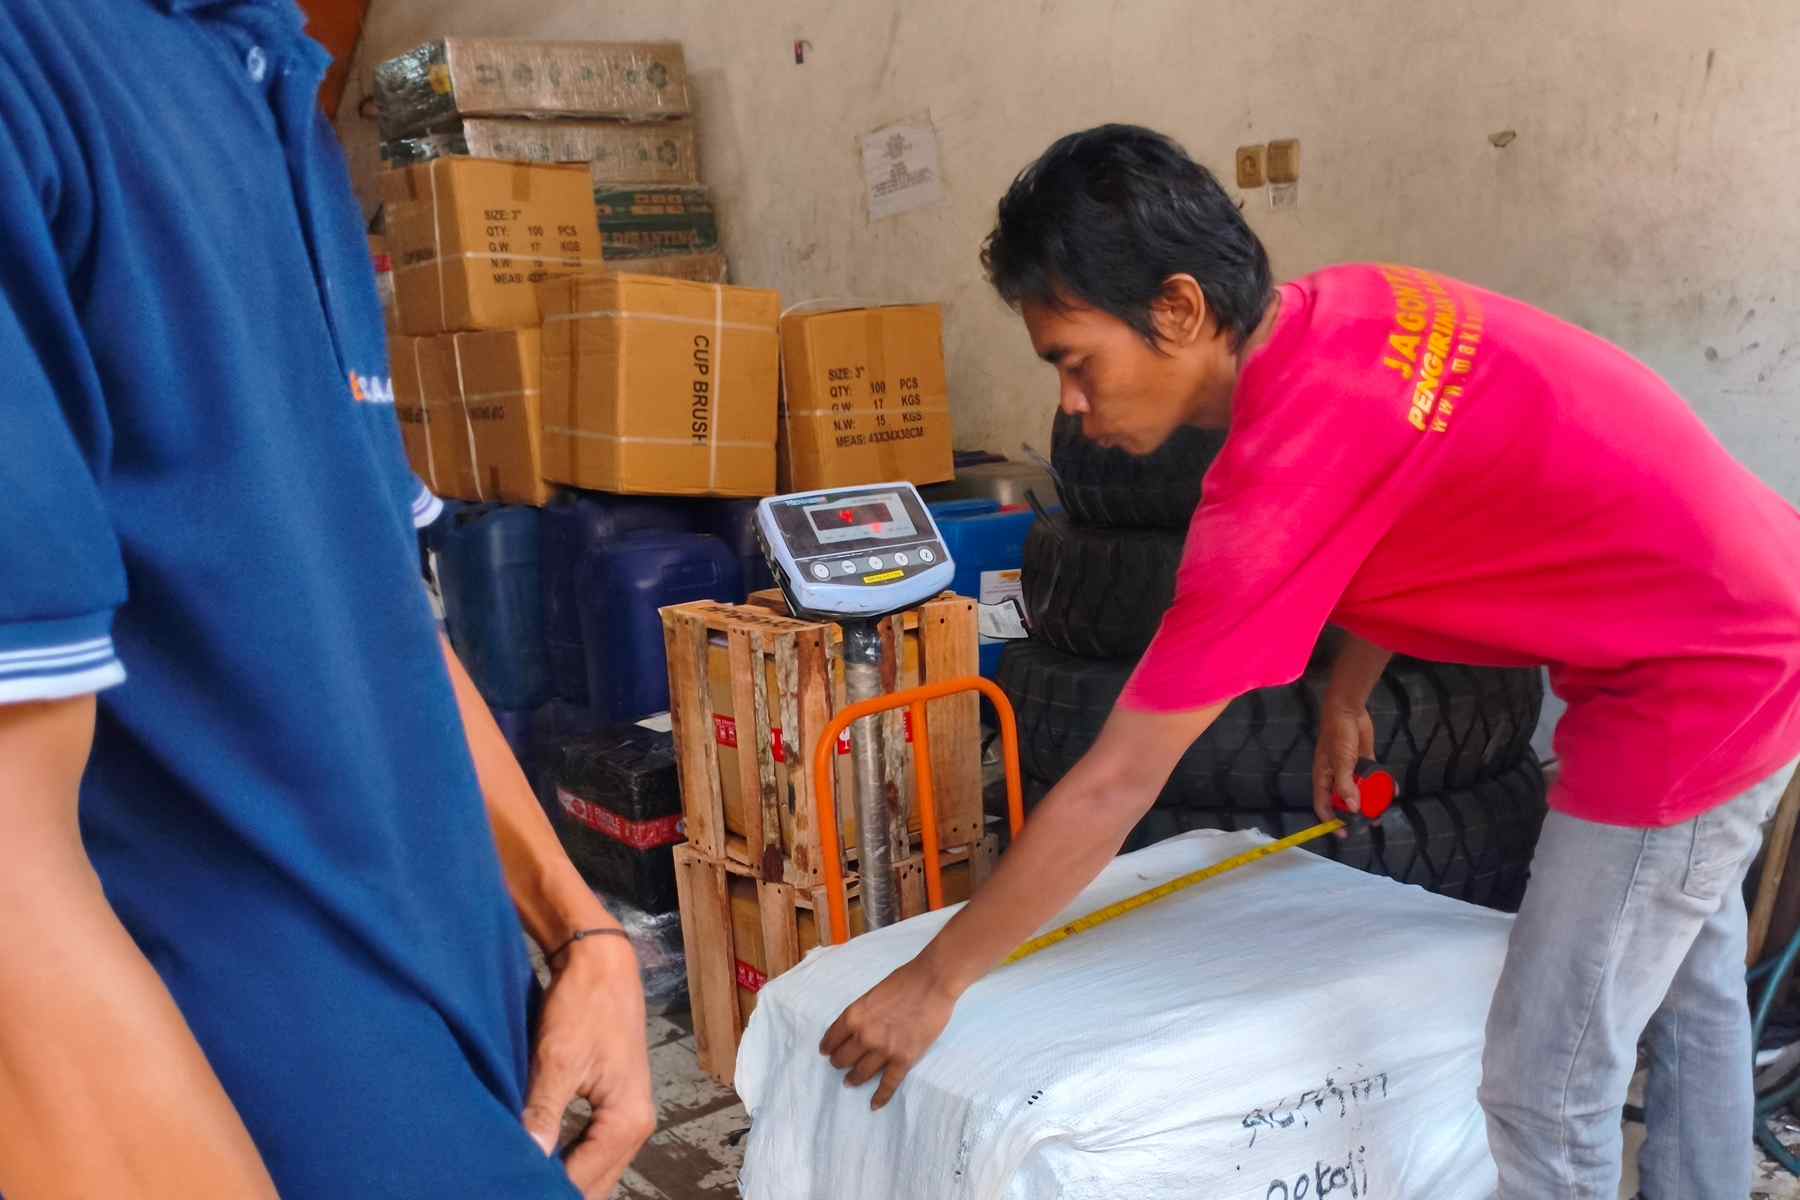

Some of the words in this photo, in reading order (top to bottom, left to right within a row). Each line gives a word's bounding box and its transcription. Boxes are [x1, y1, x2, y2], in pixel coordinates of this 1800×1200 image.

[528, 225, 545, 237] 100
[557, 225, 577, 237] PCS
[693, 334, 710, 376] CUP
[870, 381, 886, 394] 100
[899, 377, 920, 390] PCS
[874, 398, 884, 410] 17
[901, 393, 921, 407] KGS
[691, 380, 709, 447] BRUSH
[876, 414, 886, 427] 15
